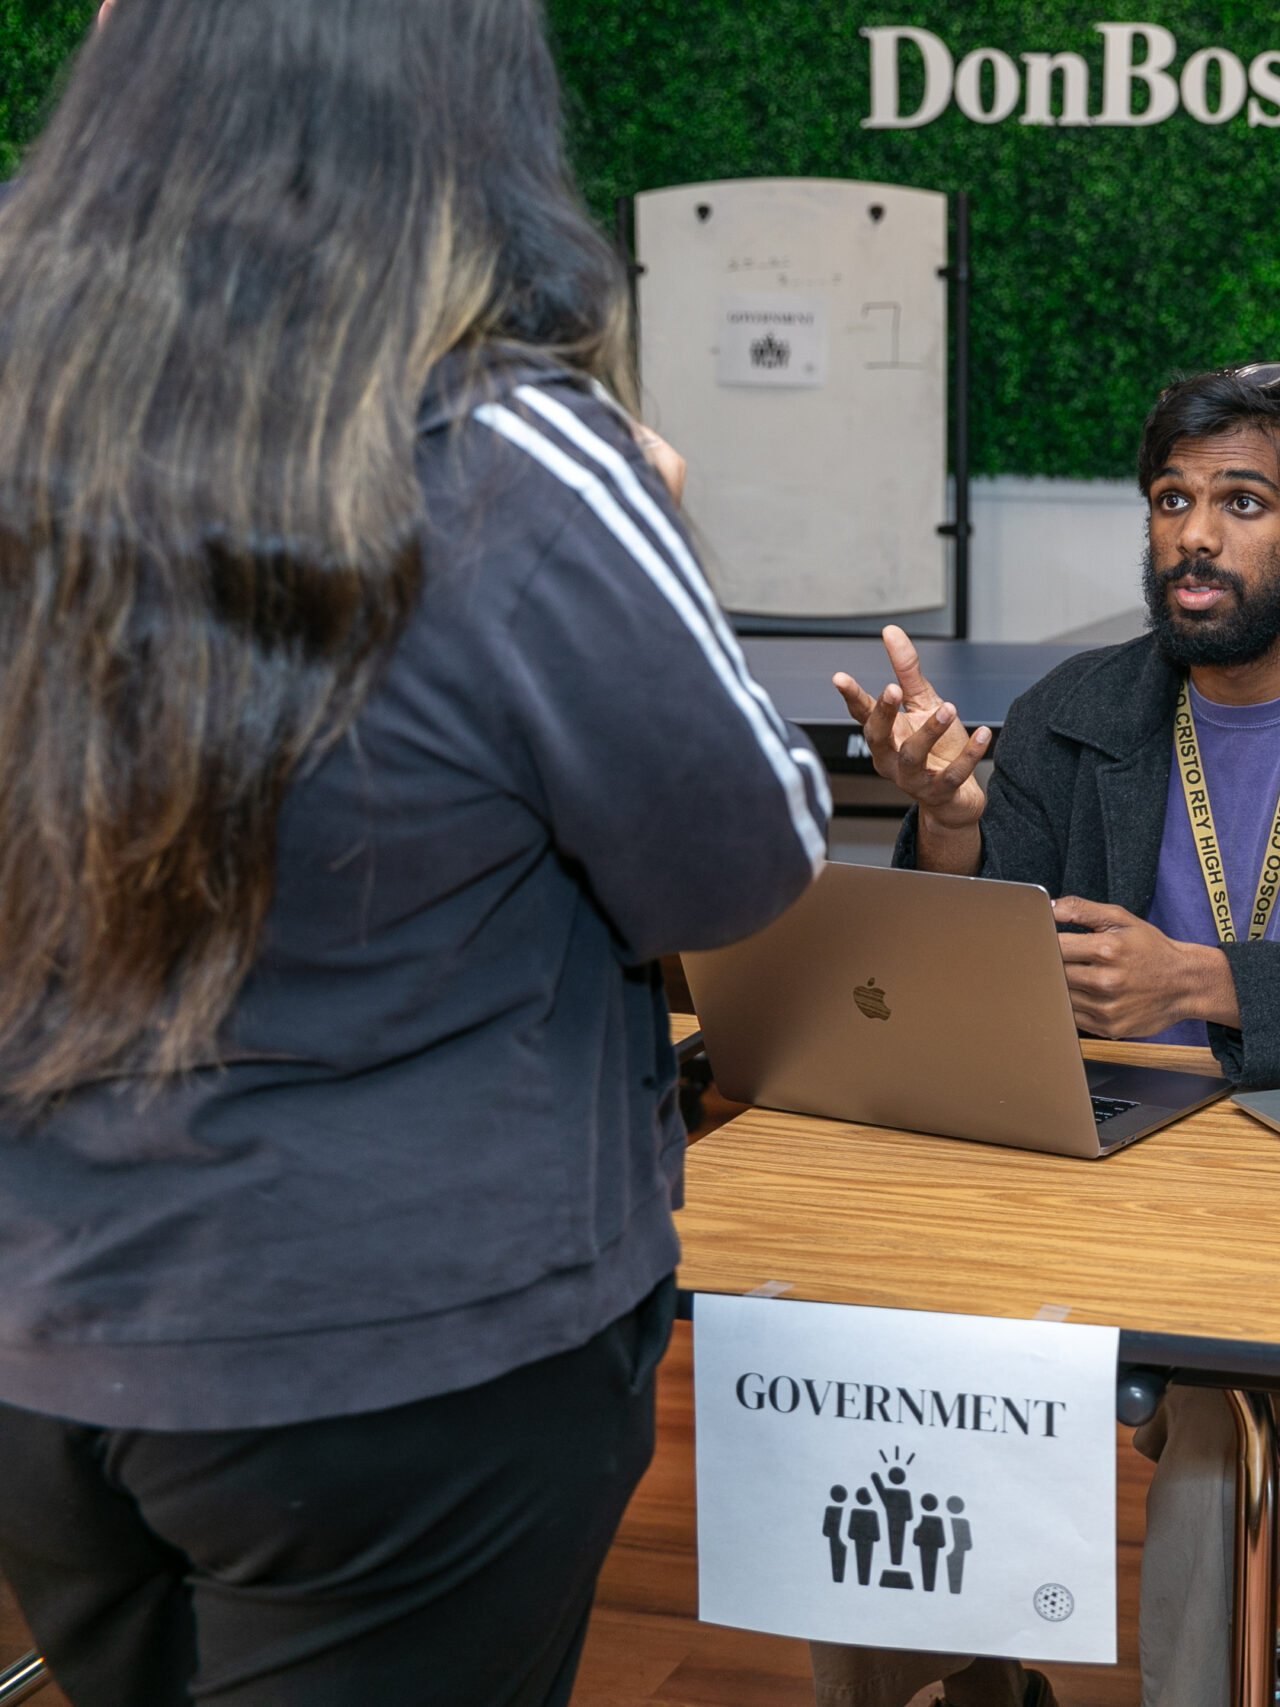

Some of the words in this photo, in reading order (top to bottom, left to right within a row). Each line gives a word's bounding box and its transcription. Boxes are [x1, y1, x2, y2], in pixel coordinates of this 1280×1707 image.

[1175, 713, 1202, 785] CRISTO
[1189, 789, 1212, 830] REY
[1199, 835, 1223, 885] HIGH
[734, 1371, 1066, 1438] GOVERNMENT
